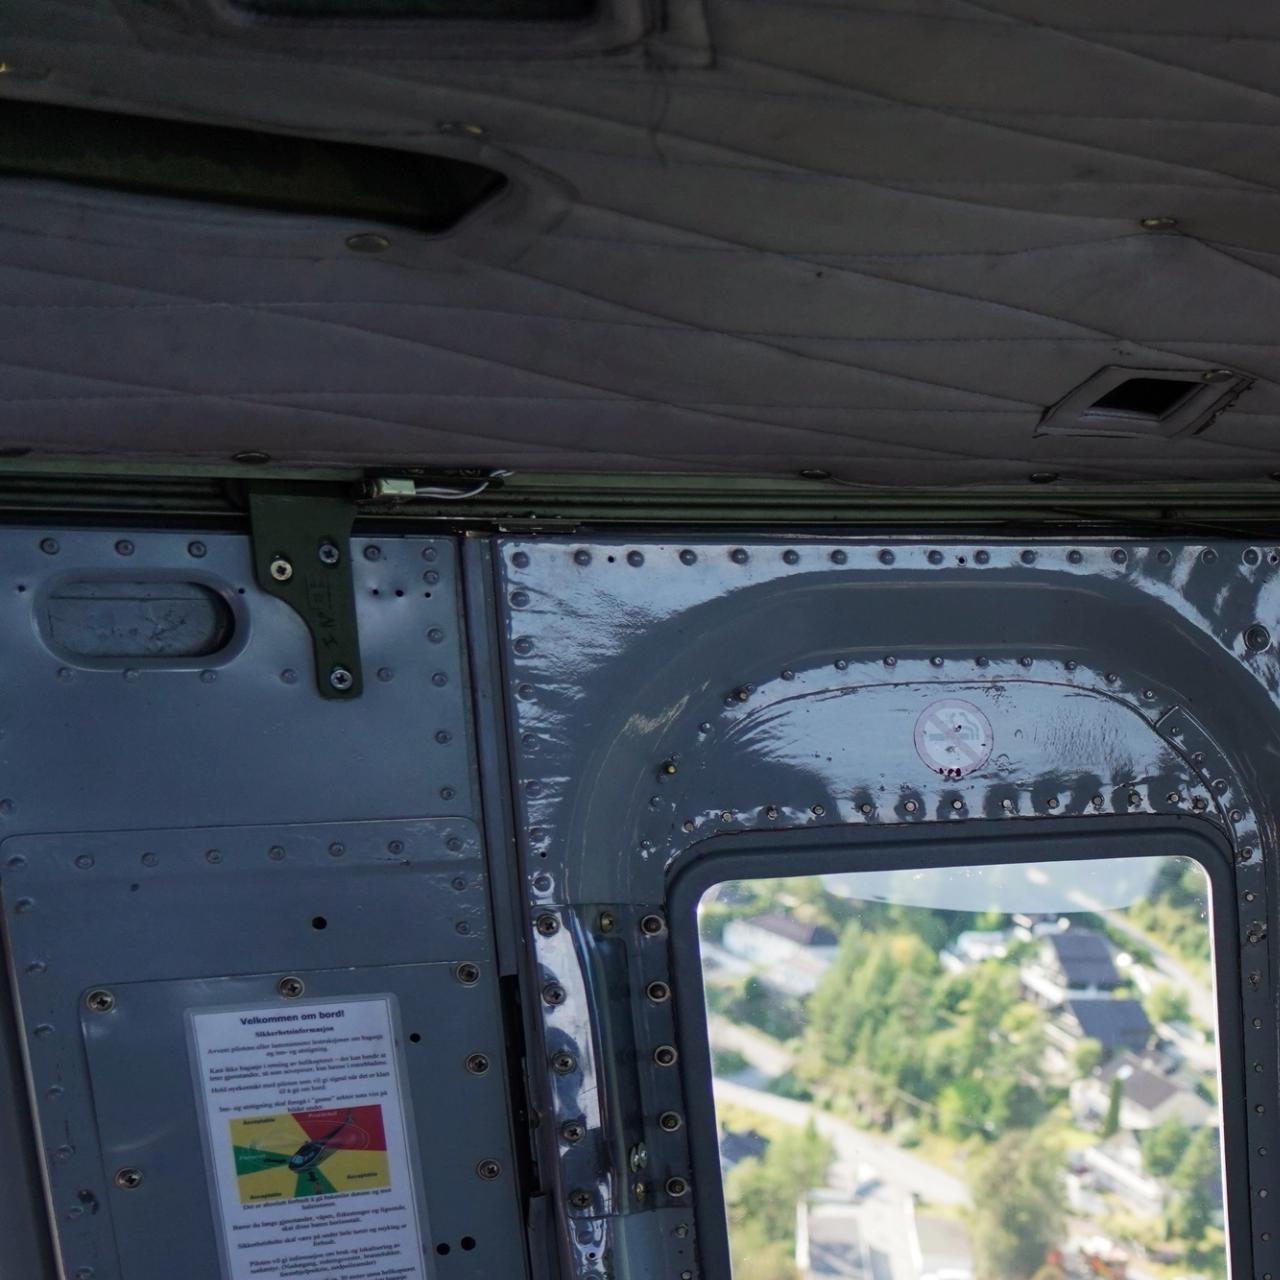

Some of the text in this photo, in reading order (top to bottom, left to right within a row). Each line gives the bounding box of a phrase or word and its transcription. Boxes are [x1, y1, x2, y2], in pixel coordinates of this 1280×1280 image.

[240, 1009, 345, 1026] Velkommen om bord!
